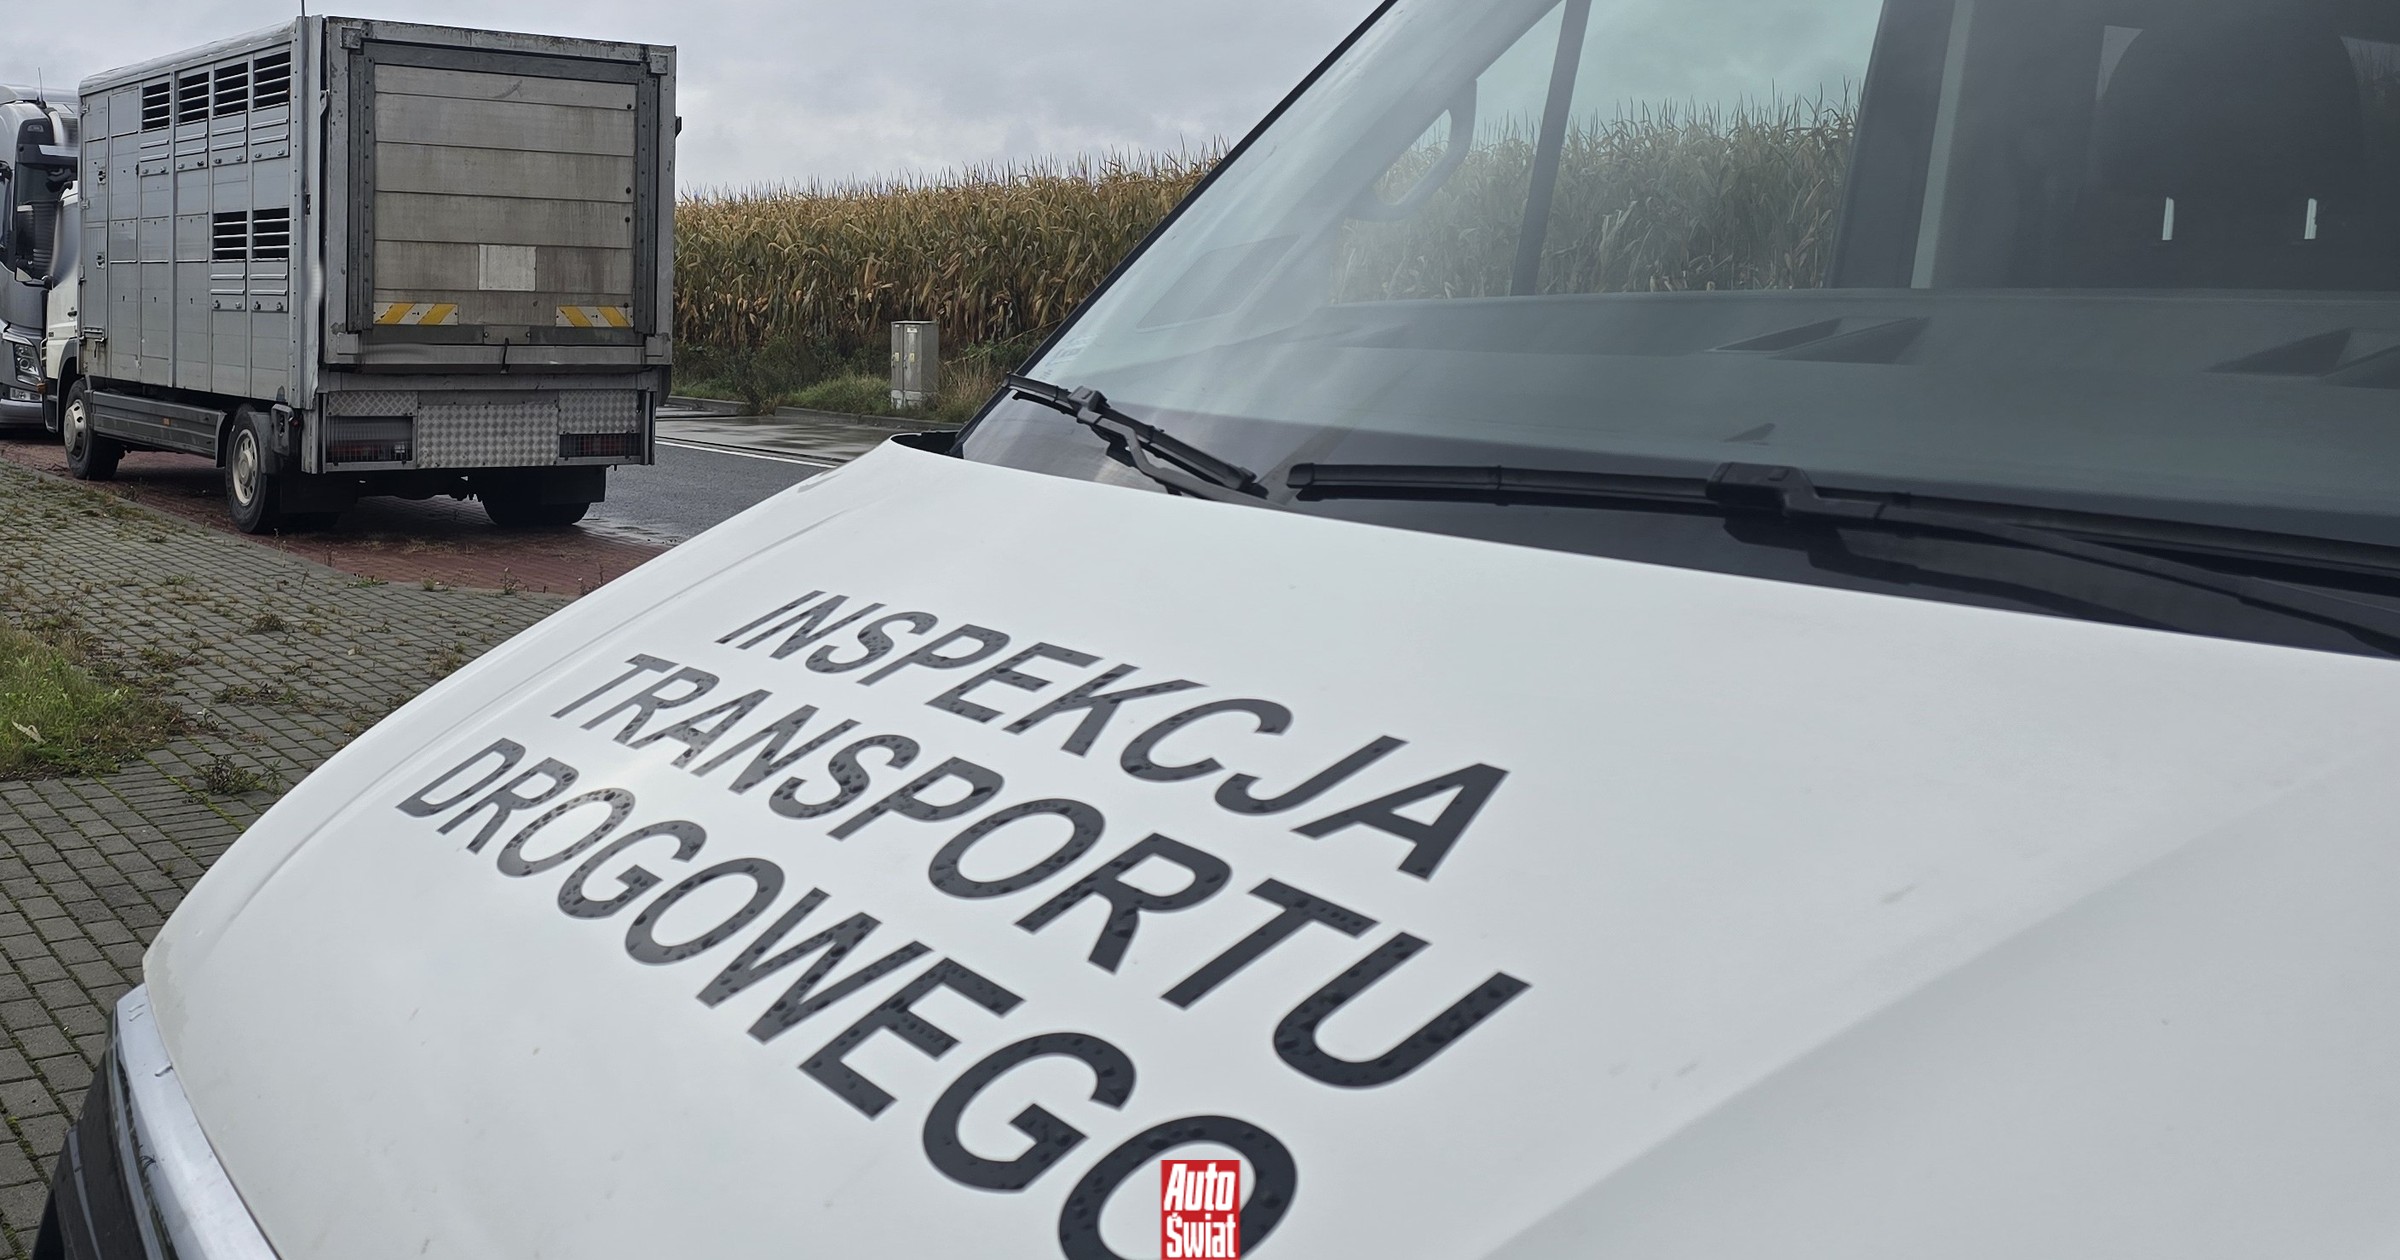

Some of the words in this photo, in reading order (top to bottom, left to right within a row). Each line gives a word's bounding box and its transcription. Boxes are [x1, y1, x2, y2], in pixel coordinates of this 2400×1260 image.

[551, 653, 1532, 1090] TRANSPORTU
[715, 590, 1510, 881] INSPEKCJA
[395, 737, 1298, 1260] DROGOWEGO
